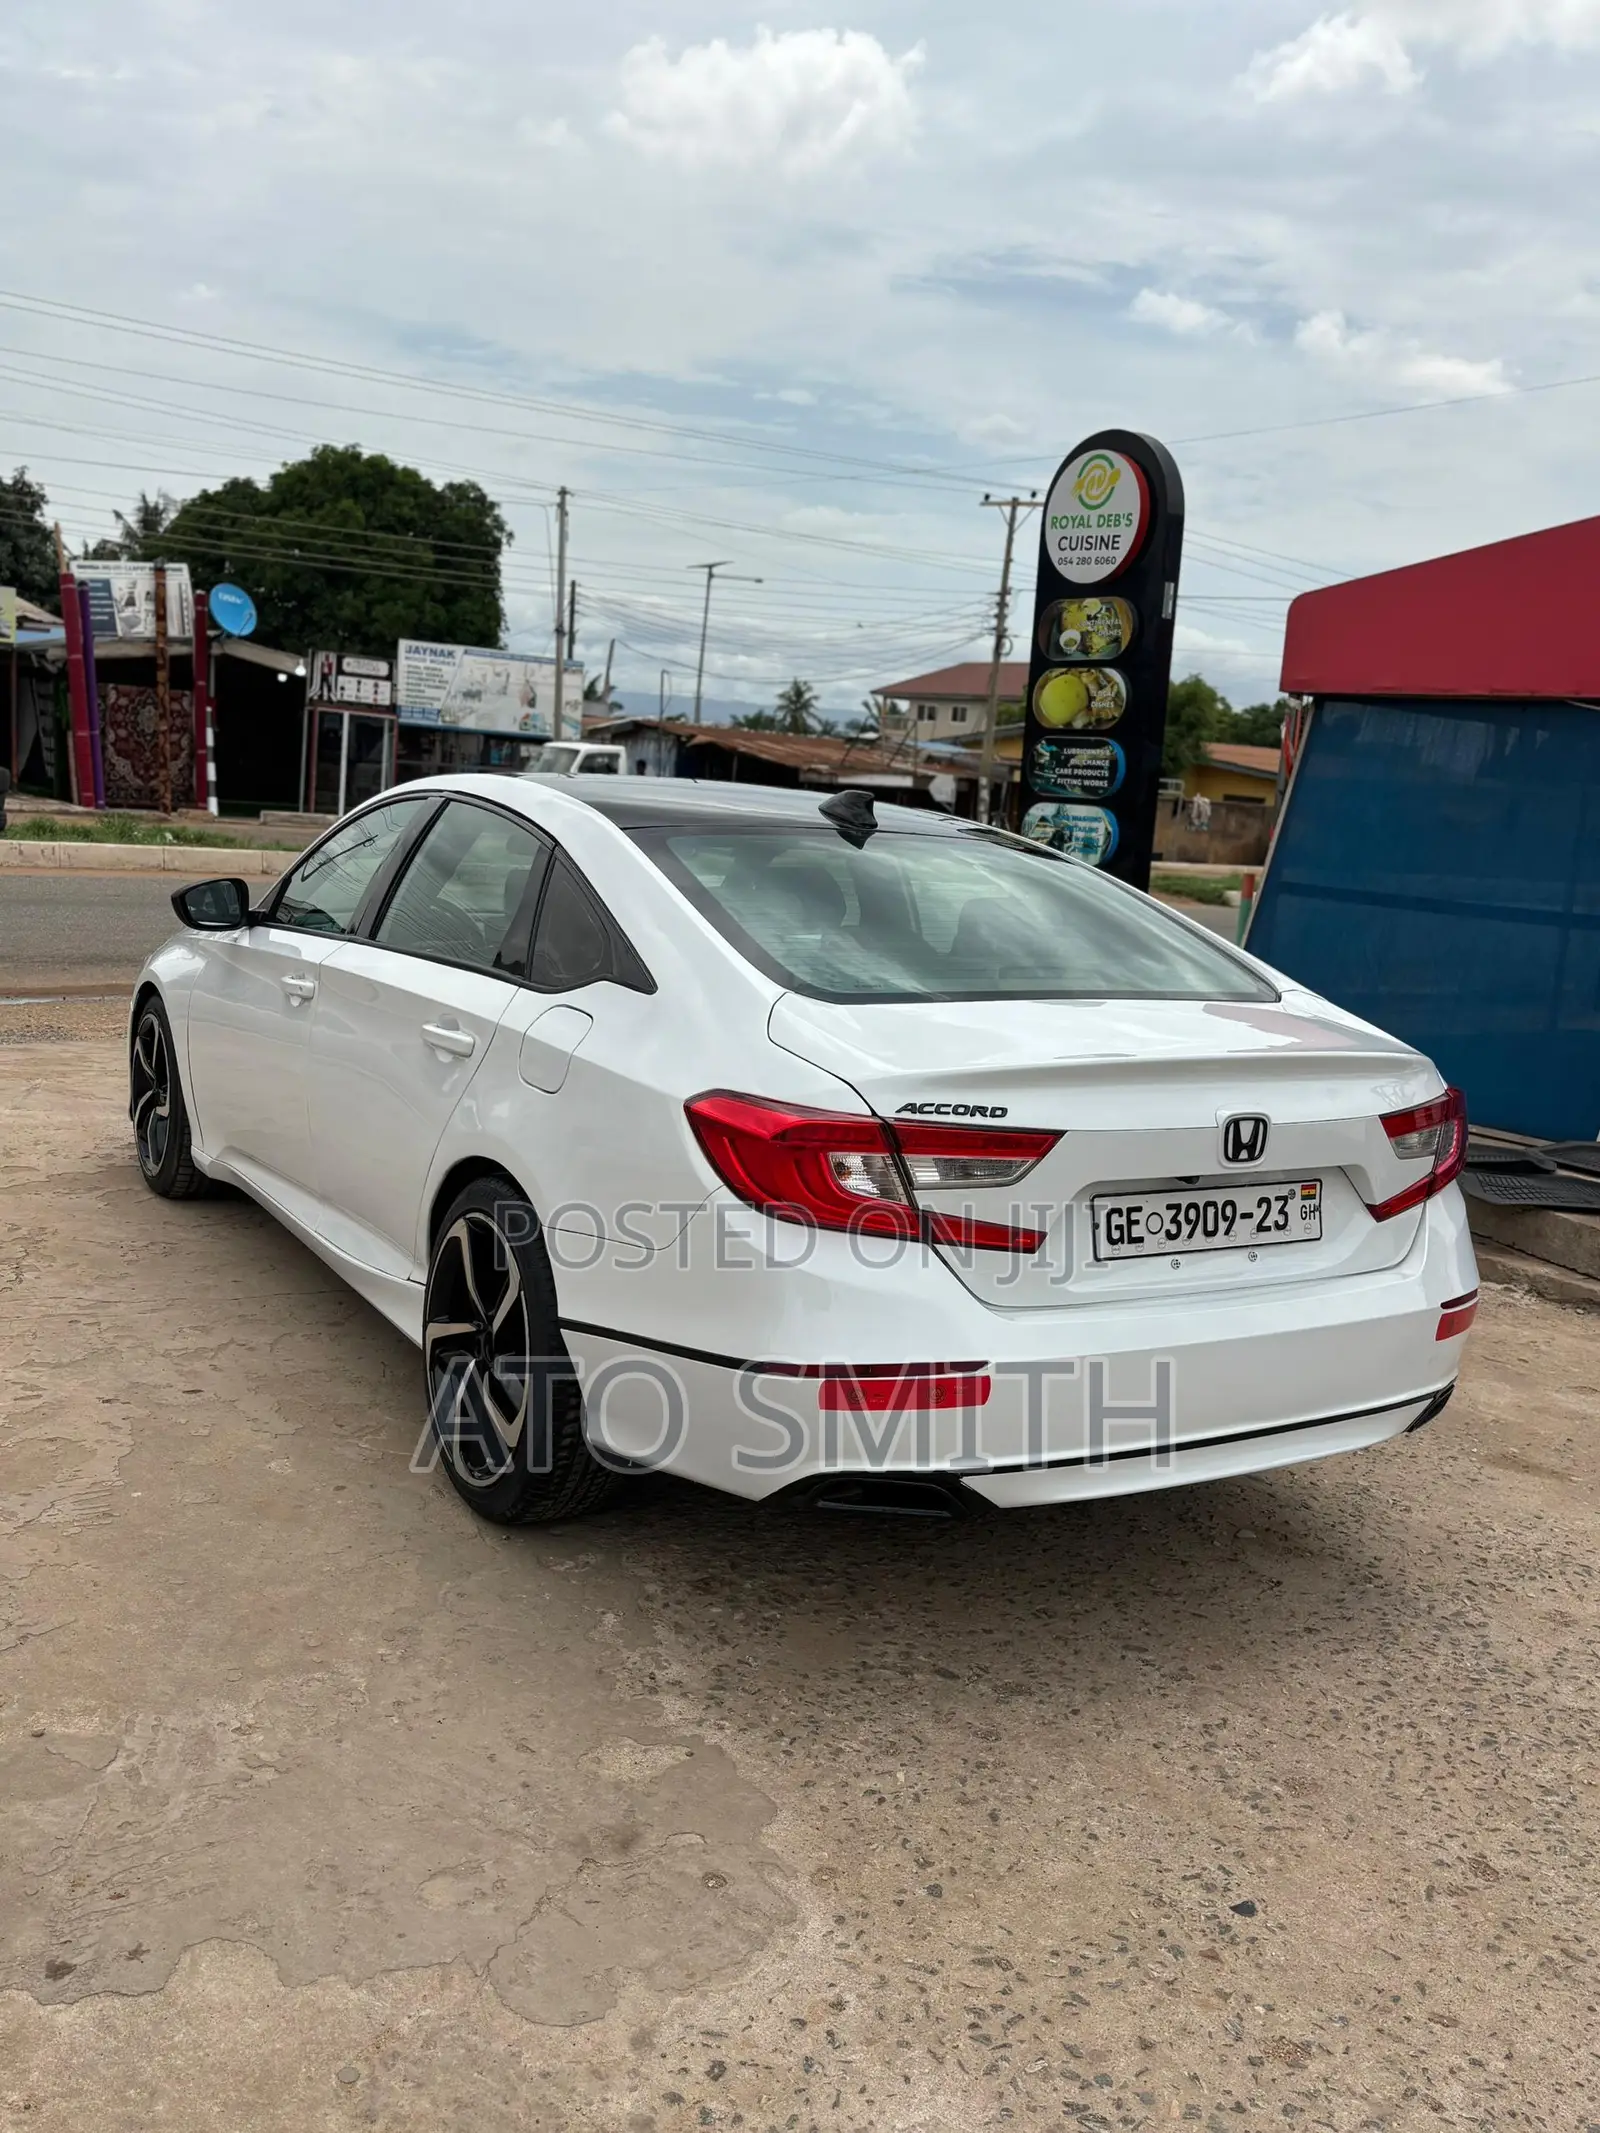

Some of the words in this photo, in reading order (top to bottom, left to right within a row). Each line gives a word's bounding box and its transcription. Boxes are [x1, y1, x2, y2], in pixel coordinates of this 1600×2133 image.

[1050, 514, 1092, 530] ROYAL
[1097, 512, 1133, 528] DEB'S
[1057, 534, 1121, 551] CUISINE
[1057, 557, 1074, 565] 054
[1075, 556, 1092, 565] 280
[1094, 556, 1117, 565] 6060
[404, 645, 456, 660] JAYNAK
[1083, 759, 1110, 767] CHANGE
[1073, 769, 1109, 778] PRODUCTS
[1057, 778, 1082, 786] FITTING
[1083, 780, 1108, 788] WORKS
[895, 1103, 1008, 1118] ACCORD
[1300, 1203, 1317, 1221] GH
